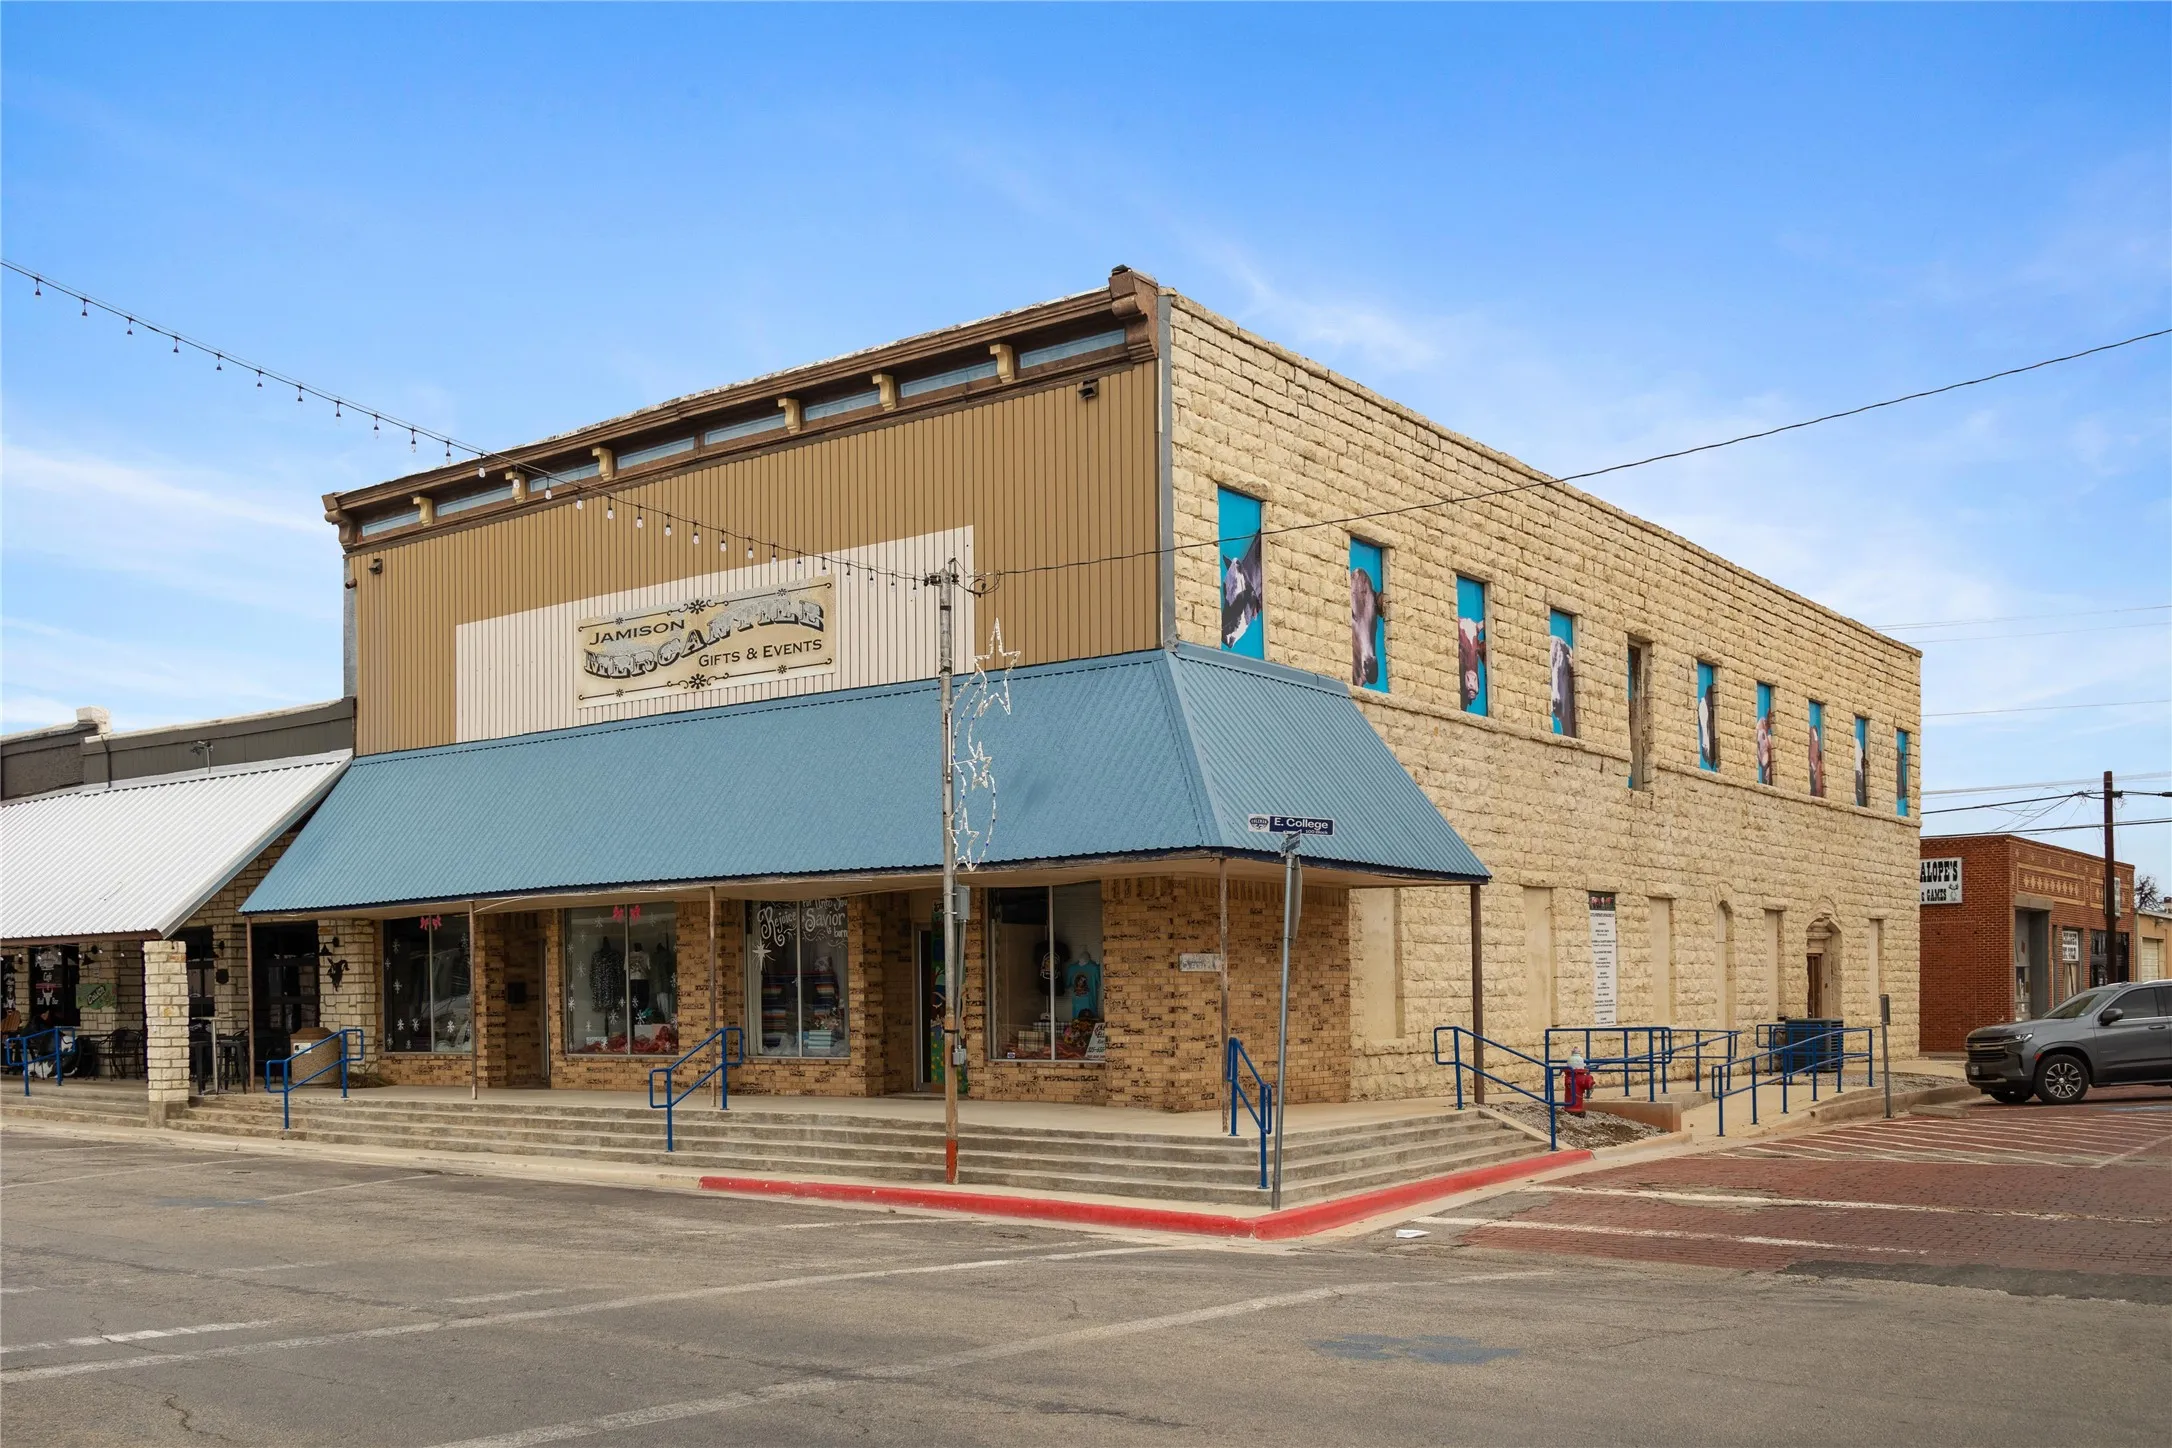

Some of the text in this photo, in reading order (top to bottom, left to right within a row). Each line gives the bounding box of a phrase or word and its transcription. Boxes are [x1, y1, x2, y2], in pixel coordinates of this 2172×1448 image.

[584, 600, 824, 678] MERCANTILE
[589, 620, 685, 645] JAMISON
[698, 638, 823, 668] GIFTS & EVENTS
[1274, 817, 1329, 830] E. College
[1926, 889, 1946, 901] GAMES
[757, 906, 797, 947] Rejoice
[804, 908, 846, 932] Savior
